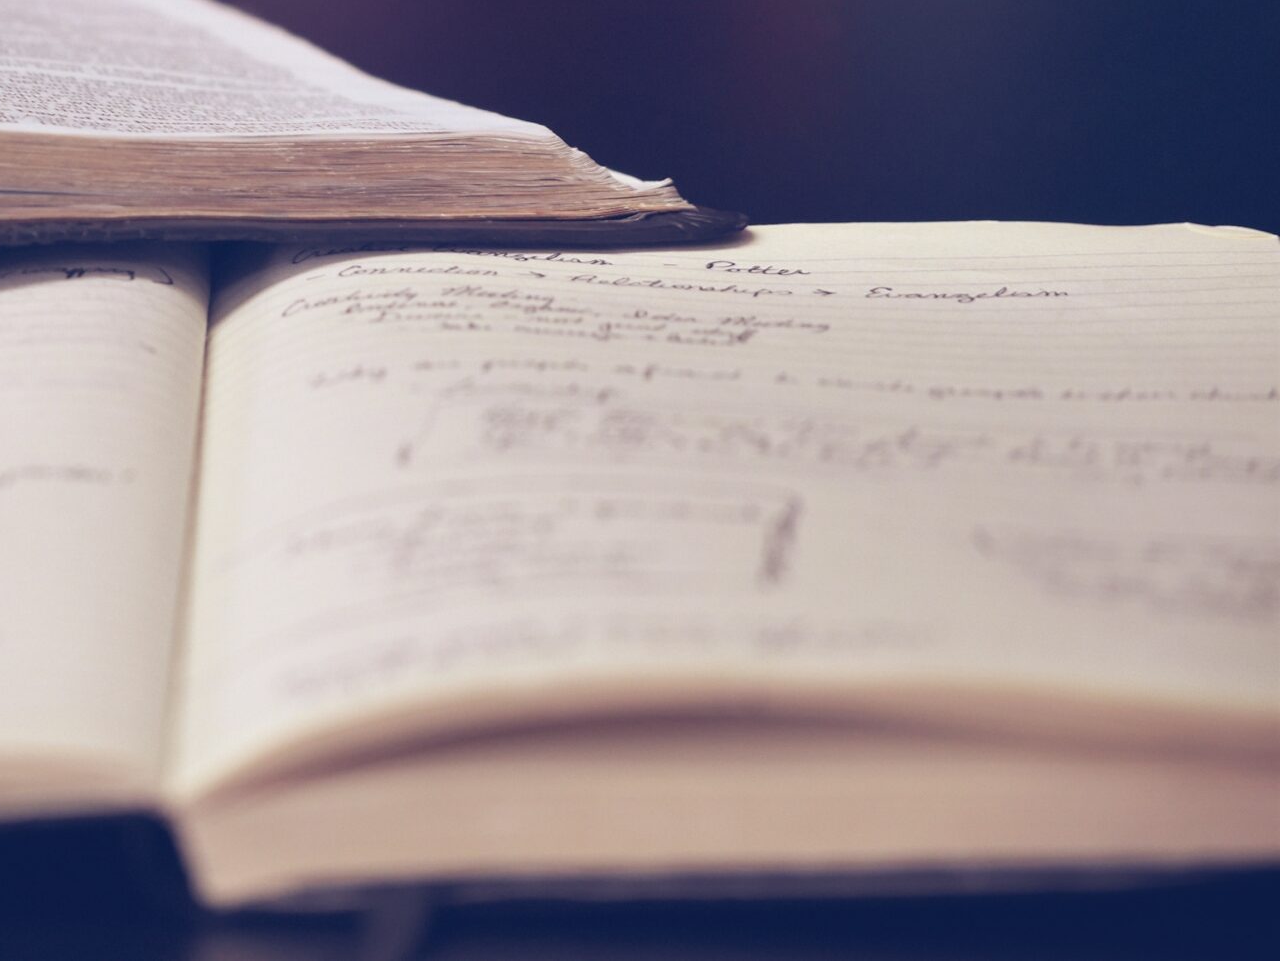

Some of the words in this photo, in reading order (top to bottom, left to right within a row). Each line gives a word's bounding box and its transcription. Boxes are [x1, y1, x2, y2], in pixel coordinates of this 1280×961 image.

[705, 259, 812, 276] Potter
[337, 264, 499, 278] Connection
[569, 274, 794, 298] Relationships
